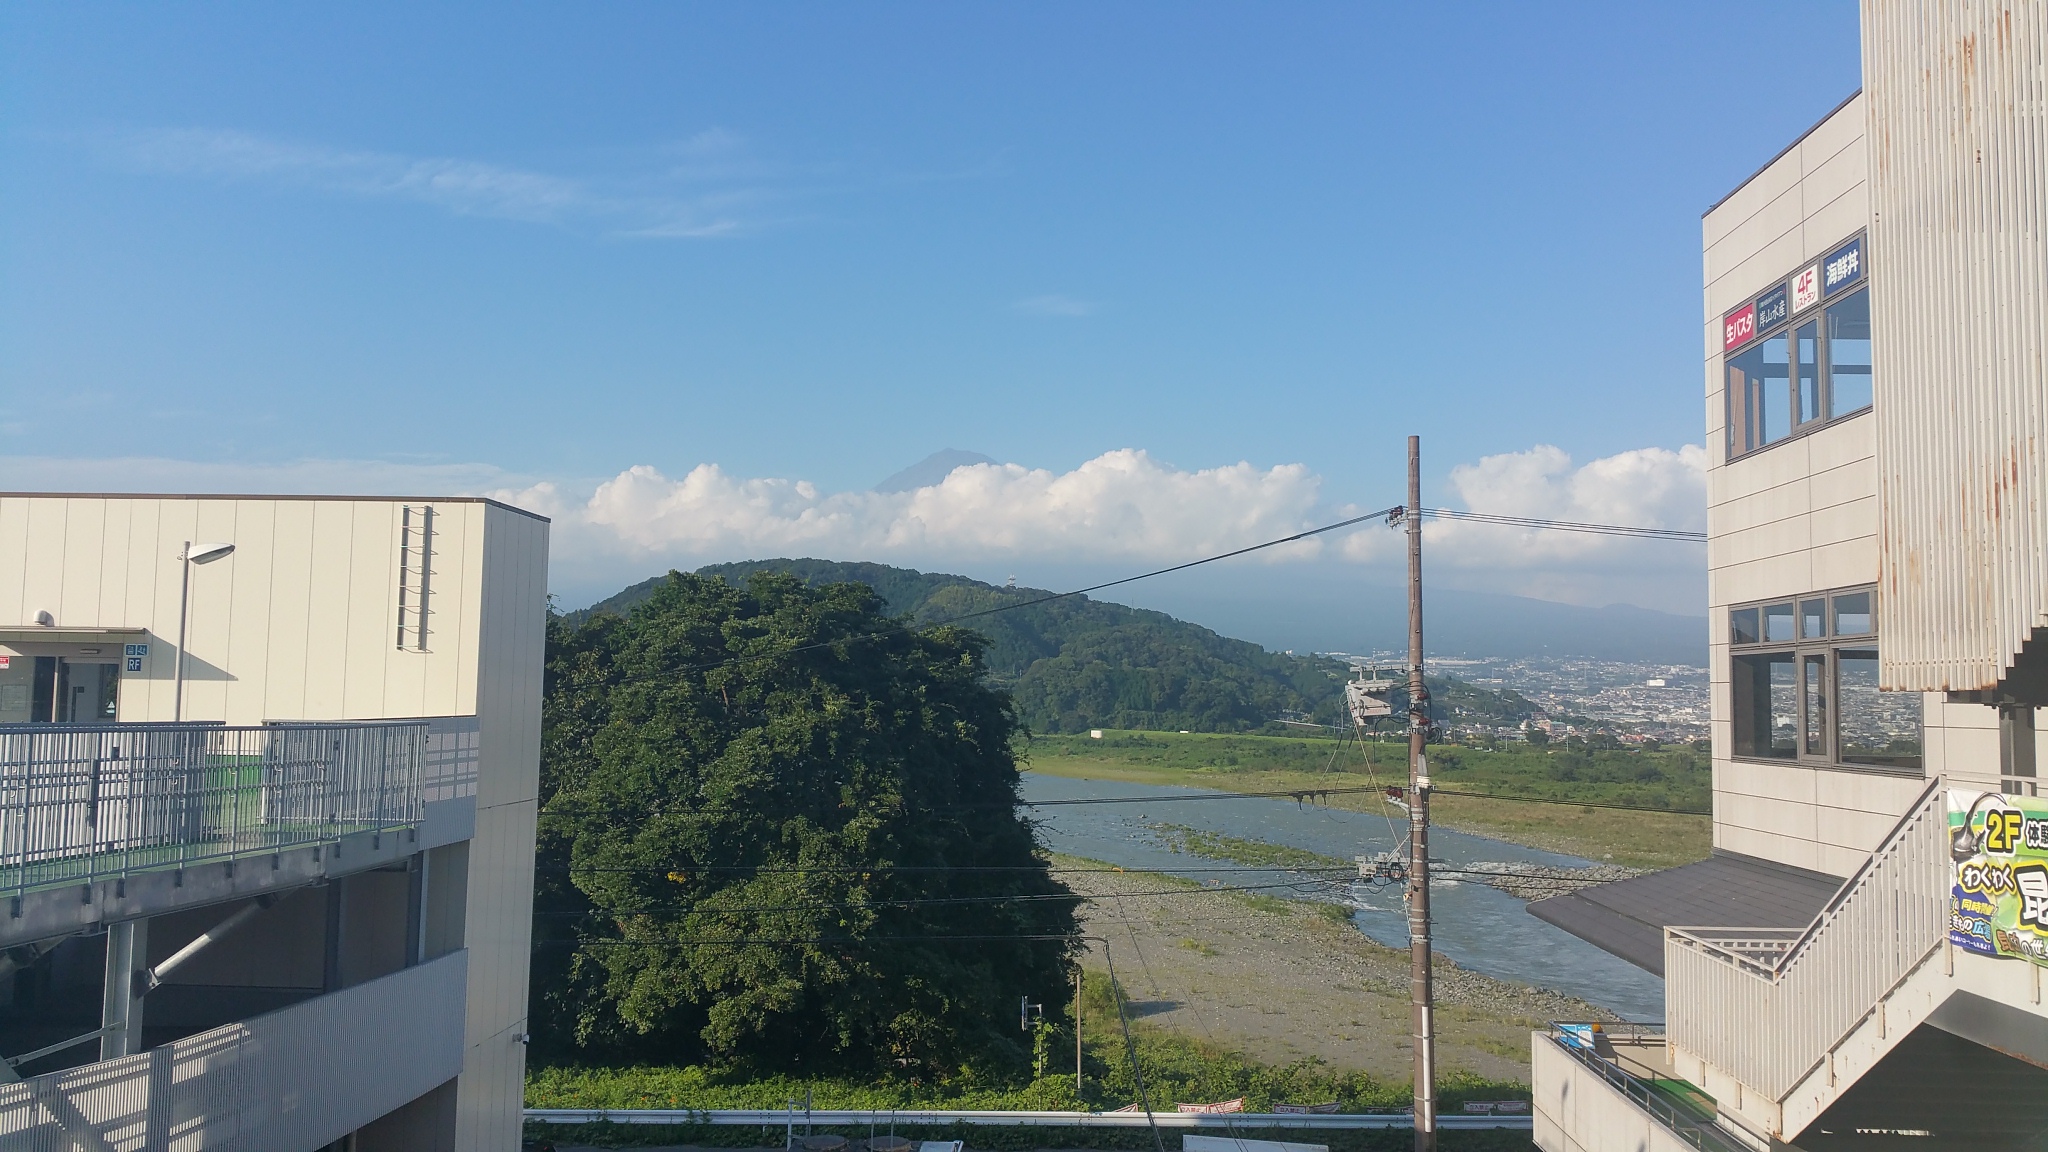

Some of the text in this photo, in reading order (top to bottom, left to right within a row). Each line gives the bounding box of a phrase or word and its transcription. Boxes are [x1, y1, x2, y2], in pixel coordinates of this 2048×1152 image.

[1826, 249, 1859, 287] 海鮮丼
[1797, 270, 1812, 294] 4F
[1795, 291, 1816, 309] レストラン
[1726, 313, 1753, 344] 生パスタ
[128, 659, 140, 670] RF
[1988, 813, 2021, 849] 2F
[1964, 865, 2014, 889] わくわく
